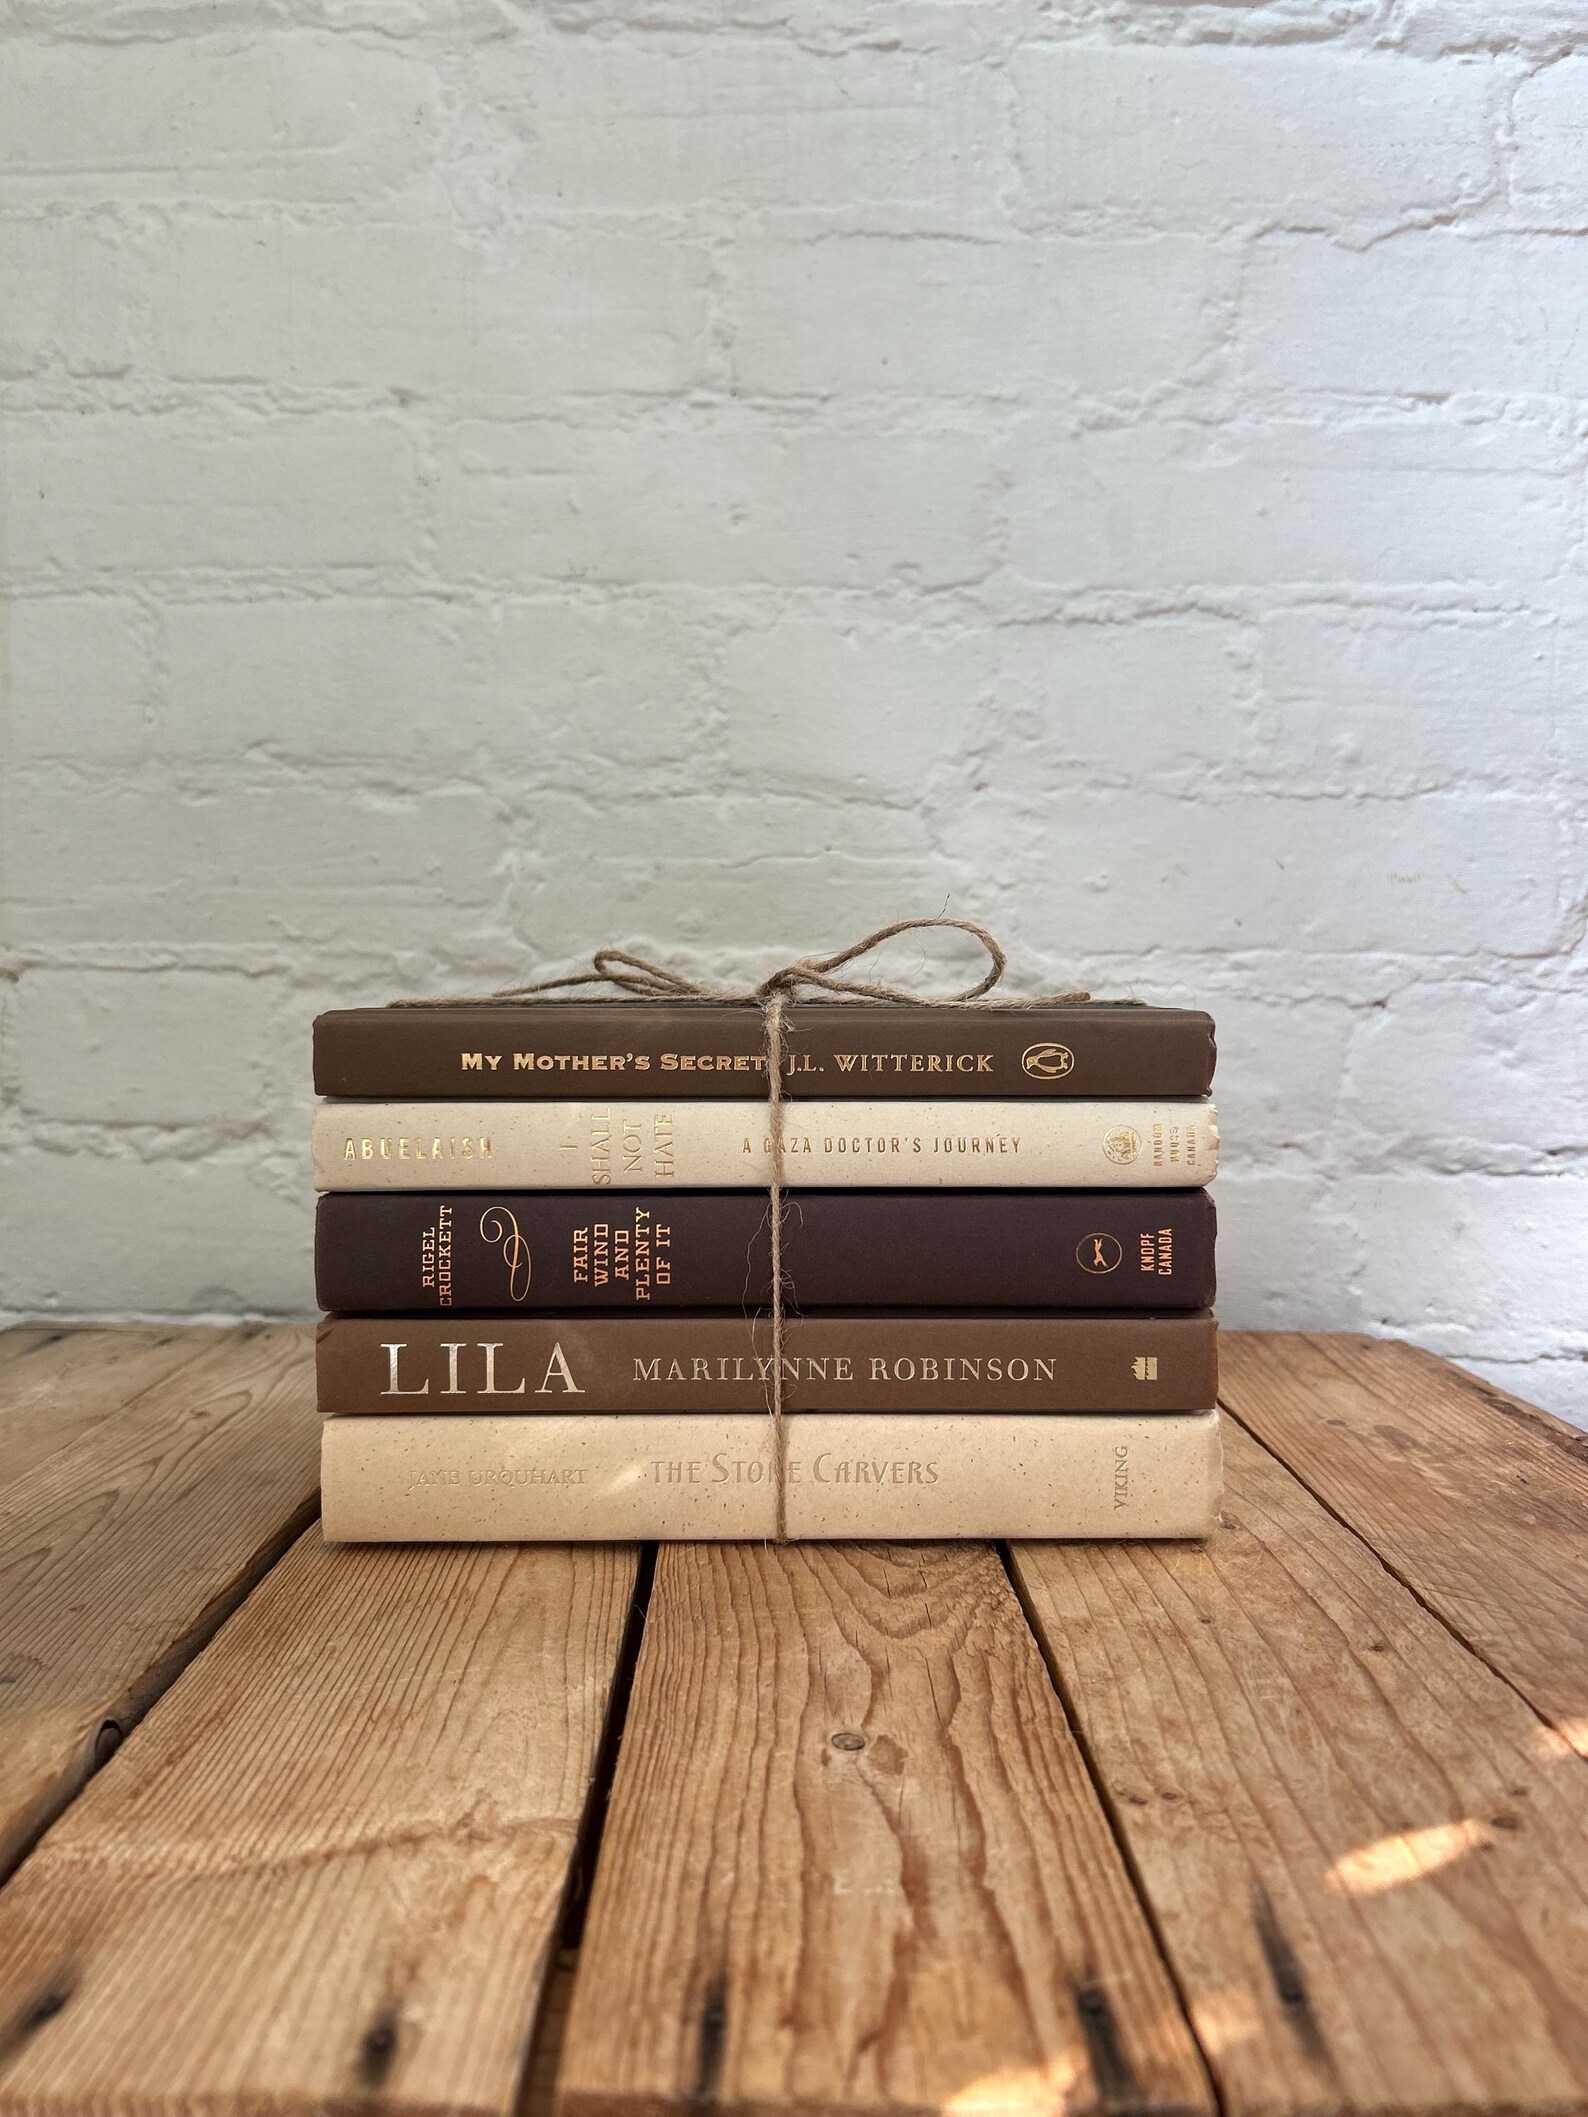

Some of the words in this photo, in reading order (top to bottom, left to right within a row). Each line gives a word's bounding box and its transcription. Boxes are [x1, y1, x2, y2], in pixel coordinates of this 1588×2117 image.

[461, 1052, 503, 1071] MY
[513, 1052, 651, 1071] MOTHER'S
[660, 1052, 767, 1072] SECRET
[786, 1054, 825, 1076] J.L.
[833, 1054, 995, 1073] WITTERICK
[343, 1137, 493, 1161] ABUELAISH
[590, 1107, 612, 1186] SHALL
[622, 1118, 643, 1174] NOT
[654, 1113, 675, 1178] HATE
[742, 1137, 752, 1154] A
[823, 1136, 923, 1154] DOCTOR'S
[933, 1136, 1022, 1154] JOURNEY
[1185, 1124, 1196, 1166] CANADA
[422, 1226, 436, 1288] RIGEL
[439, 1204, 453, 1307] CROCKETT
[573, 1226, 589, 1283] FAIR
[594, 1223, 609, 1287] WIND
[614, 1229, 630, 1281] AND
[636, 1206, 651, 1301] PLENTY
[656, 1224, 671, 1248] IT
[1140, 1231, 1155, 1273] KNOPF
[1157, 1226, 1173, 1276] CANADA
[656, 1254, 671, 1285] OF
[380, 1341, 586, 1396] LILA
[632, 1356, 854, 1382] MARILYNNE
[868, 1356, 1057, 1382] ROBINSON
[407, 1470, 461, 1491] JANE
[467, 1469, 589, 1489] URQUHART
[650, 1460, 702, 1485] THE
[812, 1452, 939, 1485] CARVERS
[1113, 1444, 1129, 1511] VIKING
